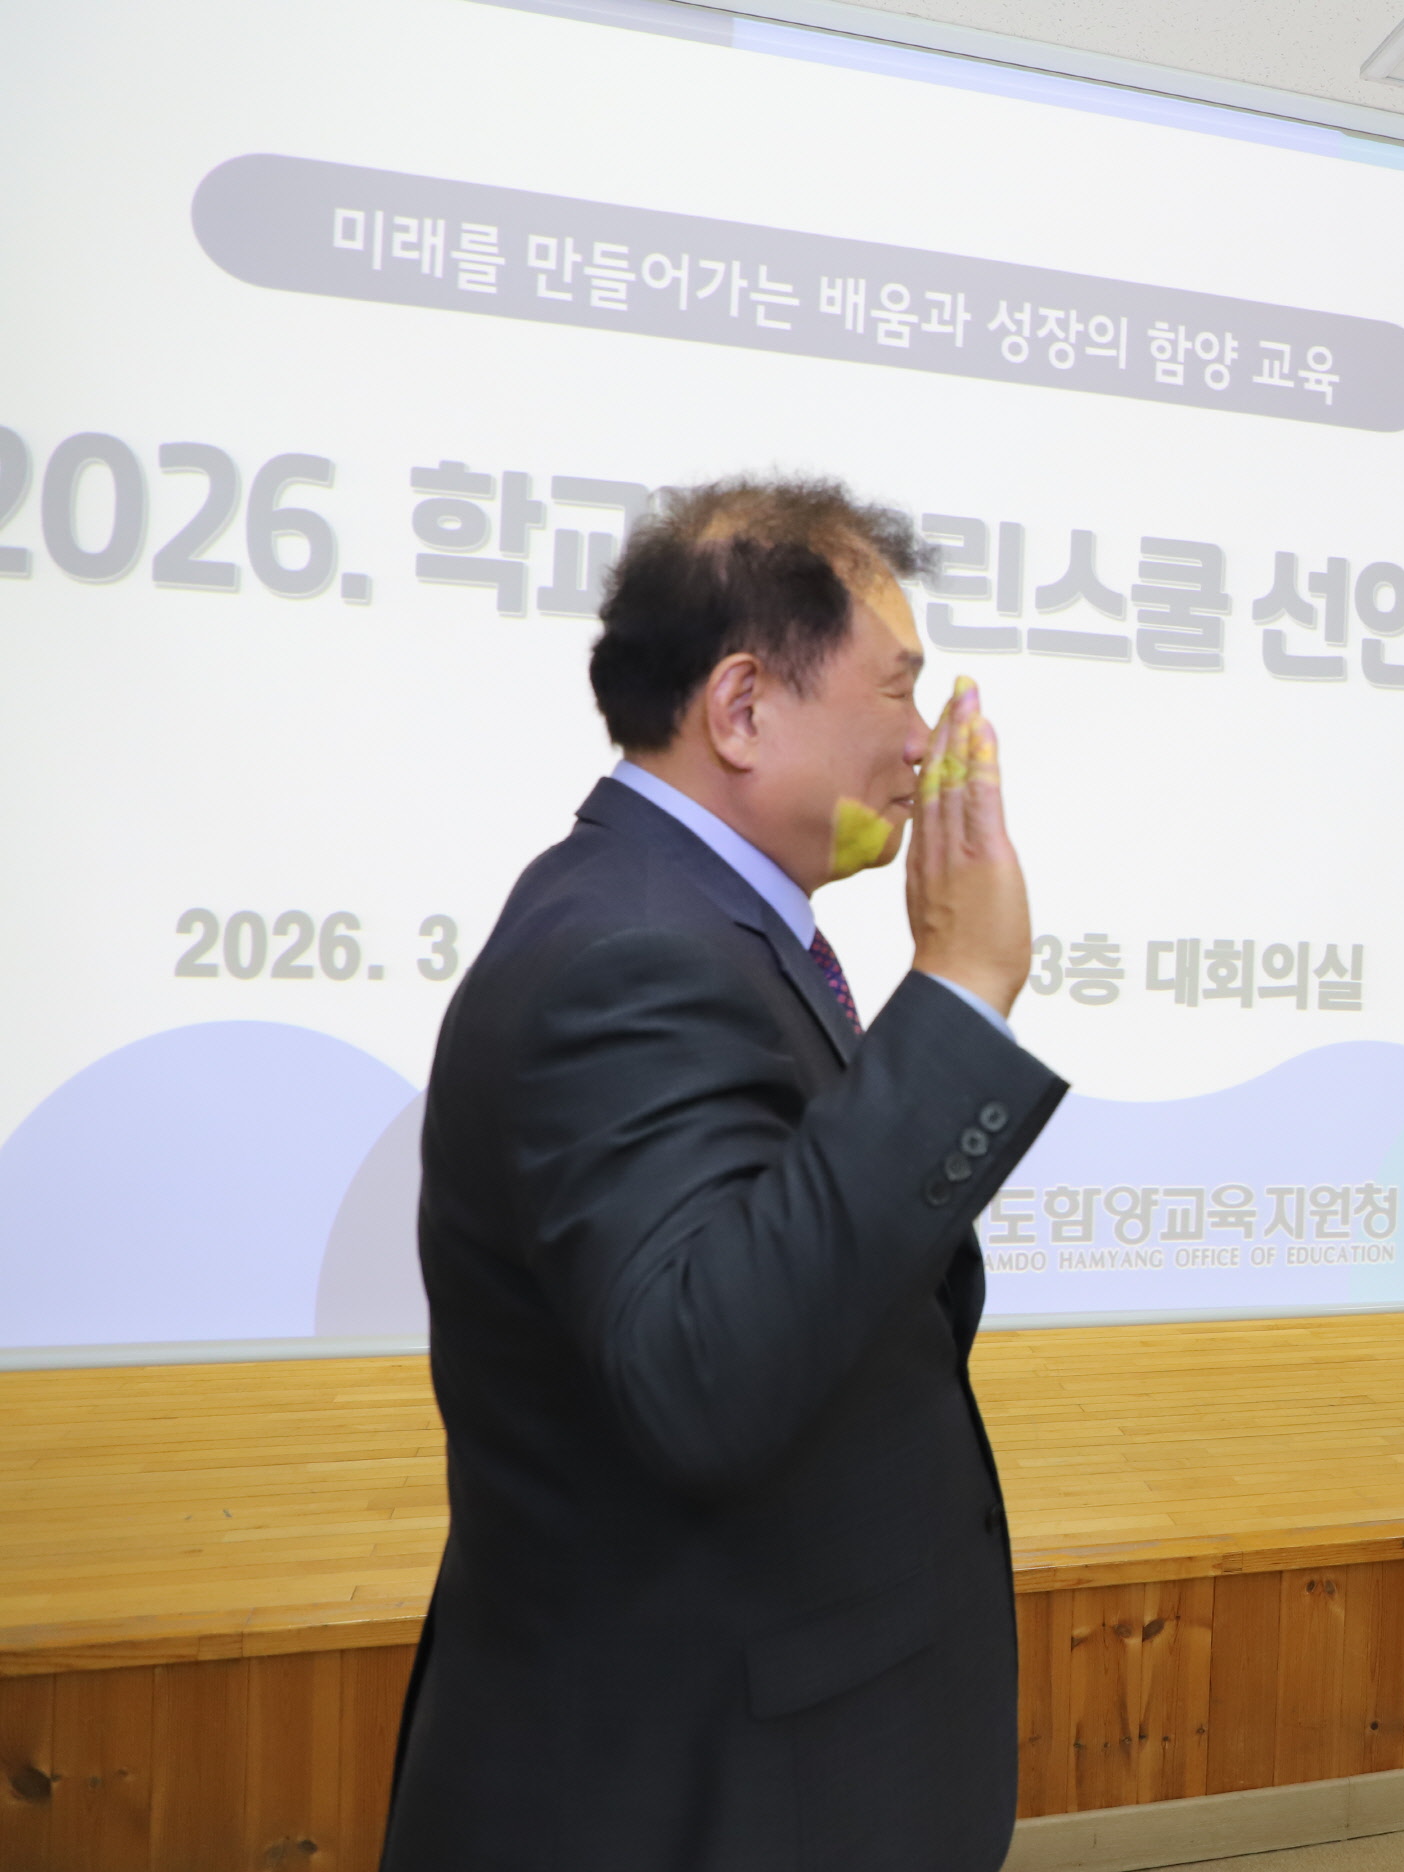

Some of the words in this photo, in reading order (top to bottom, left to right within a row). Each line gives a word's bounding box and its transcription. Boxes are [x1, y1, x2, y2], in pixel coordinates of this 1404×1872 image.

[333, 207, 506, 295] 미래를
[526, 233, 800, 331] 만들어가는
[819, 275, 972, 349] 배움과
[987, 299, 1127, 369] 성장의
[1147, 320, 1239, 391] 함양
[1252, 339, 1341, 405] 교육
[410, 459, 690, 618] 학교
[864, 504, 1232, 673] 린스쿨
[174, 907, 386, 982] 2026.
[416, 913, 474, 982] 3
[1029, 932, 1126, 1006] 3층
[1145, 937, 1365, 1012] 대회의실
[975, 1182, 1399, 1246] 도함양교육지원청
[1058, 1249, 1163, 1270] HAMYANG
[1174, 1247, 1240, 1269] OFFICE
[1250, 1246, 1276, 1266] OF
[1286, 1243, 1395, 1265] EDUCATION
